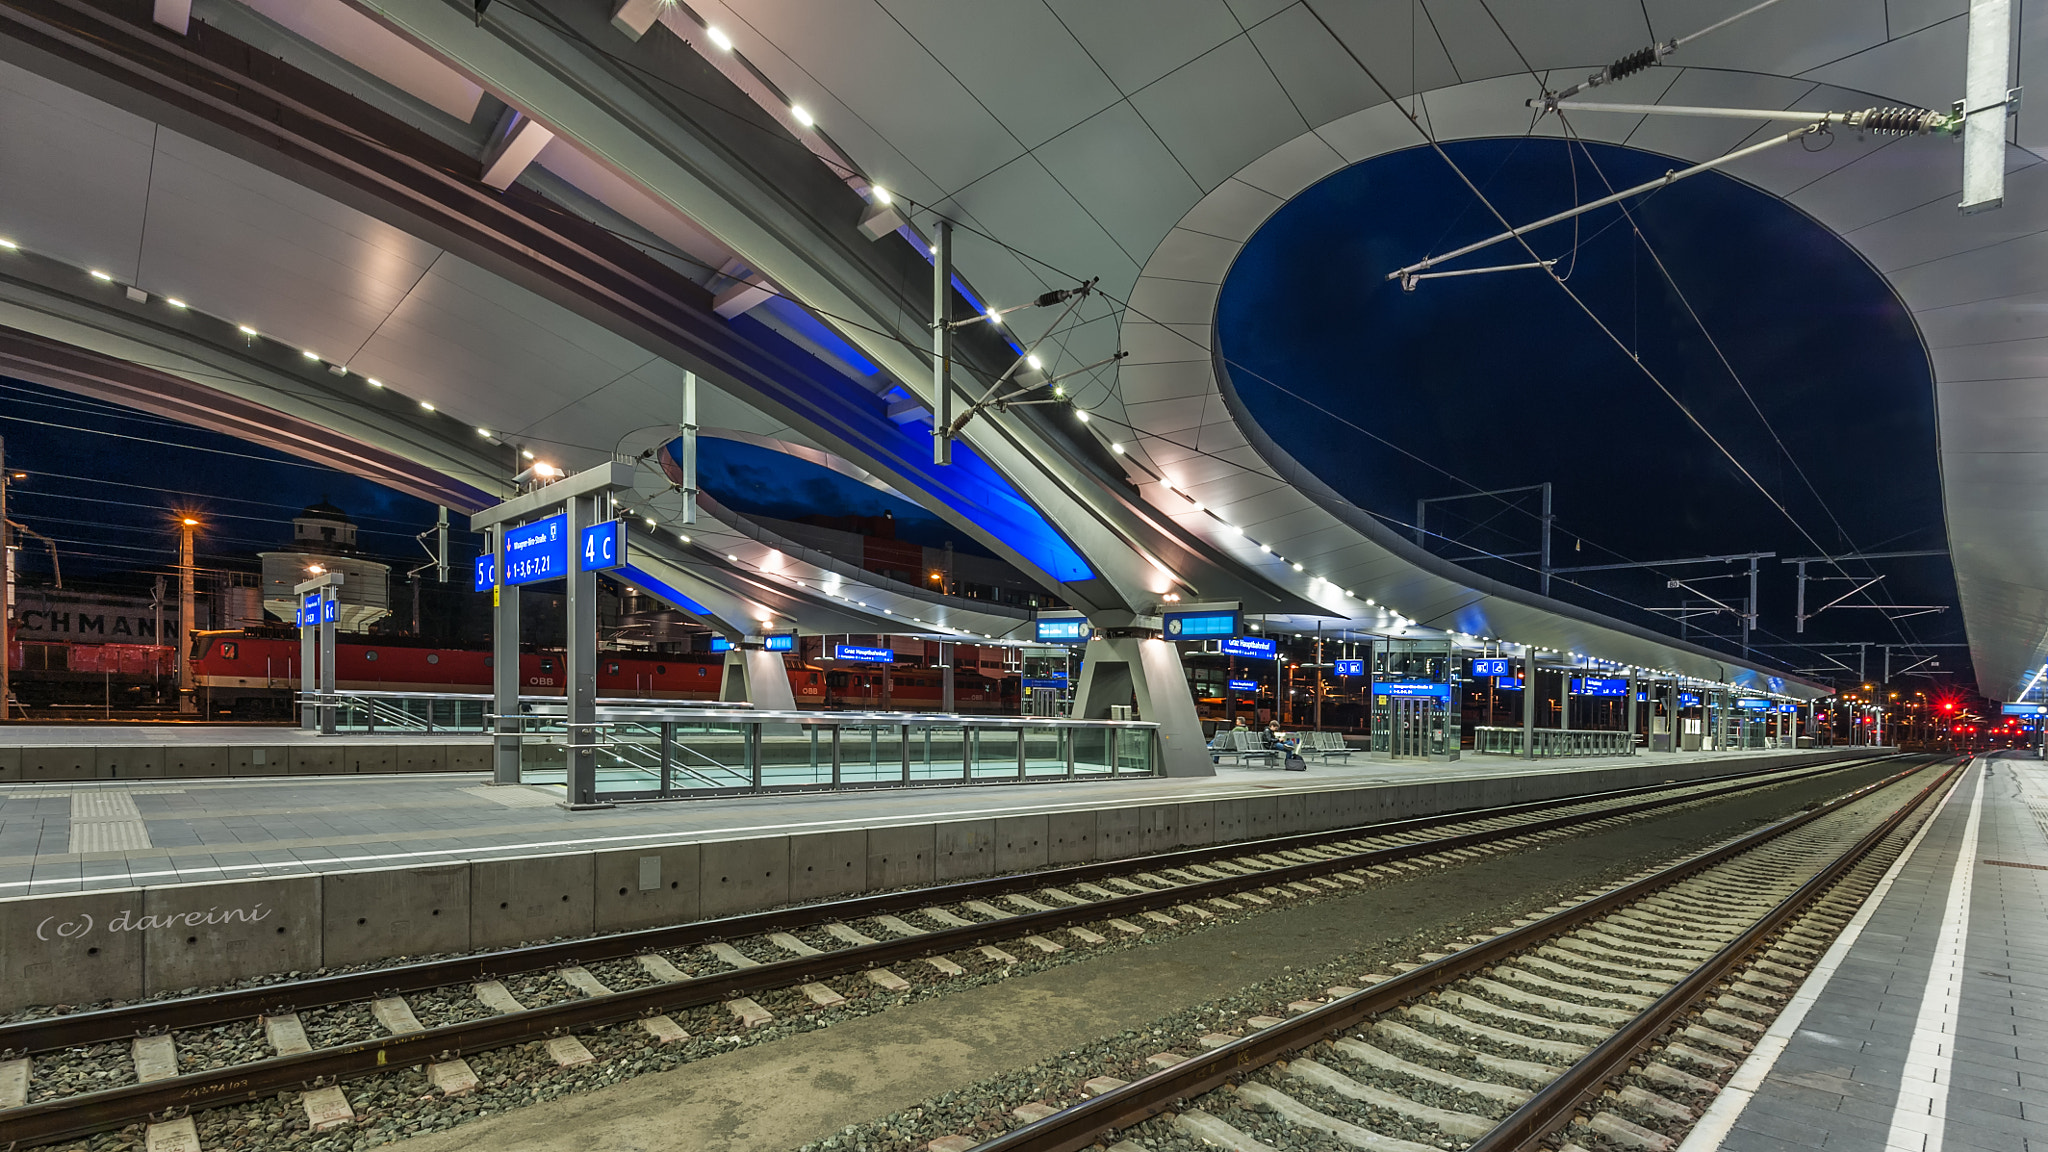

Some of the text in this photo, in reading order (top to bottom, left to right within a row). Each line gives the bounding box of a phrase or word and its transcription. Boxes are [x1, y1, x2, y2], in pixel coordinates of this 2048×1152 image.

[586, 535, 595, 562] 4
[478, 562, 484, 584] 5
[325, 604, 330, 619] 6
[844, 647, 888, 657] Graz Hauptbahnhof
